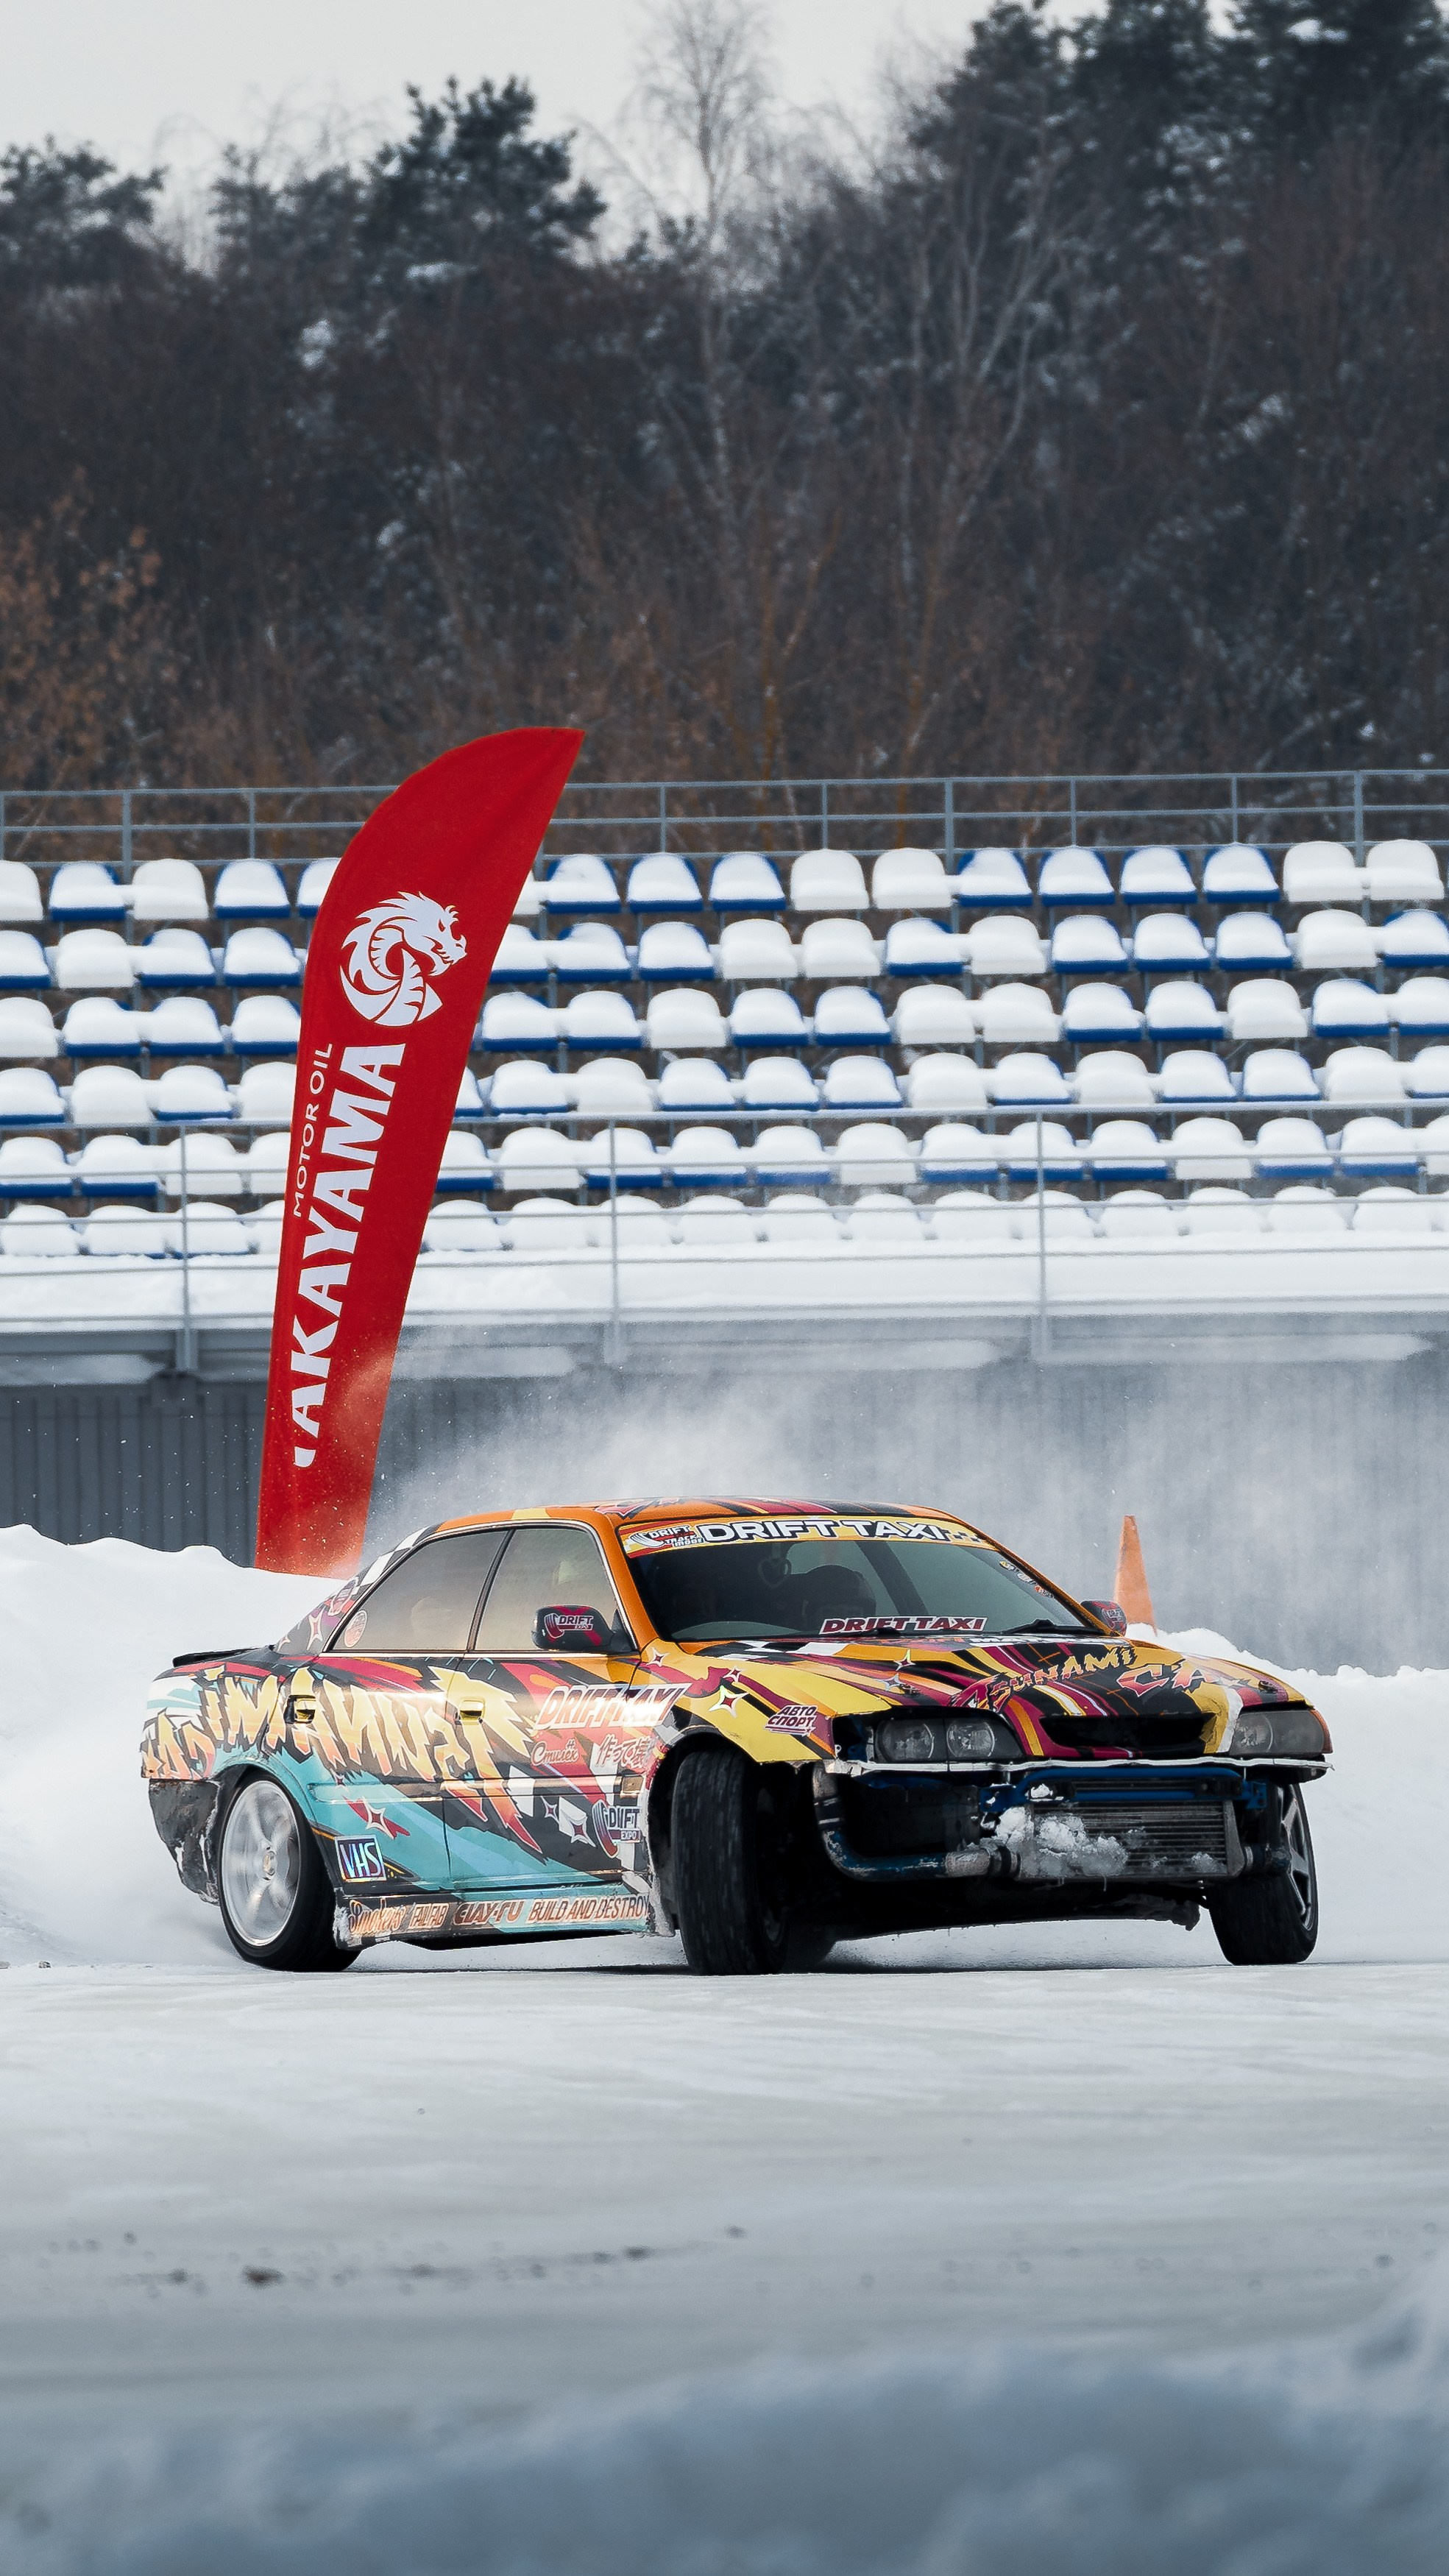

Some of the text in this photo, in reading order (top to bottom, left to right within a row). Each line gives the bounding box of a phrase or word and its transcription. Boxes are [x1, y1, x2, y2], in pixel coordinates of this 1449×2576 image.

[294, 1043, 333, 1218] MOTOR OIL
[648, 1525, 689, 1539] DRIFT
[697, 1520, 952, 1543] DRIFT TAXI
[559, 1616, 592, 1625] DRIFT
[821, 1618, 985, 1634] DRIFT TAXI
[536, 1687, 623, 1725] DRIFT
[777, 1706, 818, 1716] АВТО
[768, 1716, 815, 1727] СПОРТ
[621, 1830, 637, 1840] EXPO
[341, 1842, 382, 1878] VHS
[528, 1895, 649, 1922] BUILD AND DESTROY
